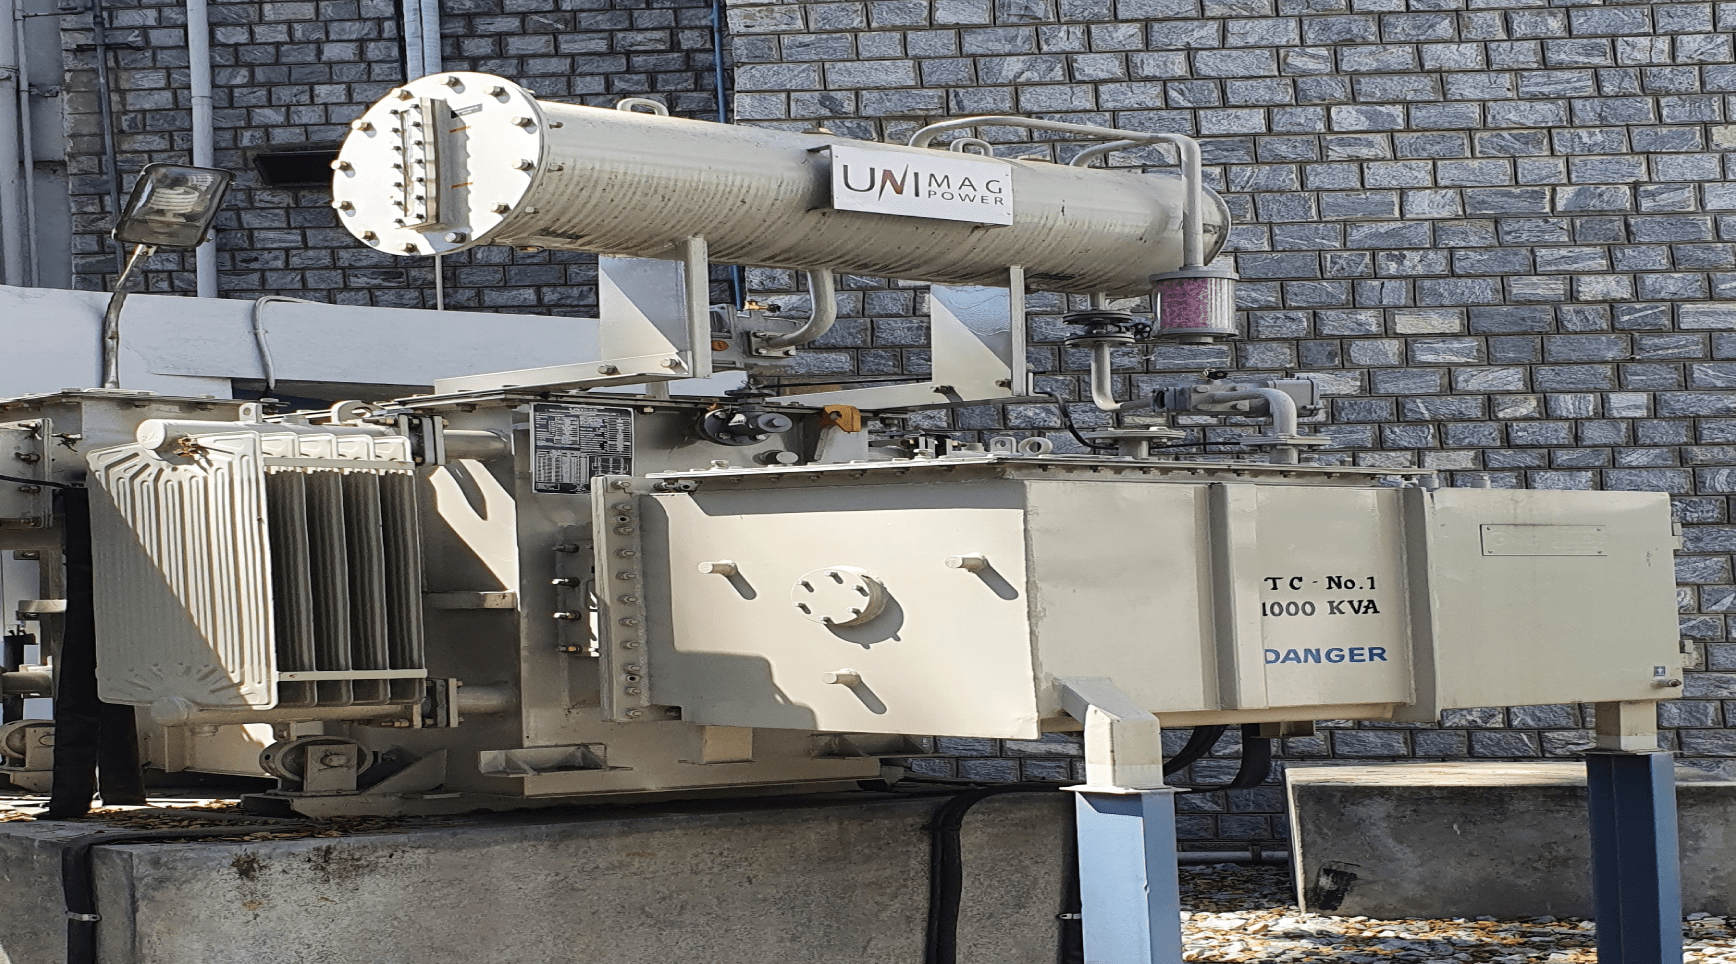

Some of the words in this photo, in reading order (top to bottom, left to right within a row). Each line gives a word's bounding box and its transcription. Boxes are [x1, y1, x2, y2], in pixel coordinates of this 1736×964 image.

[928, 189, 1004, 206] POWER
[1262, 601, 1316, 617] 1000
[1326, 599, 1380, 615] KVA
[1264, 646, 1388, 664] DANGER
